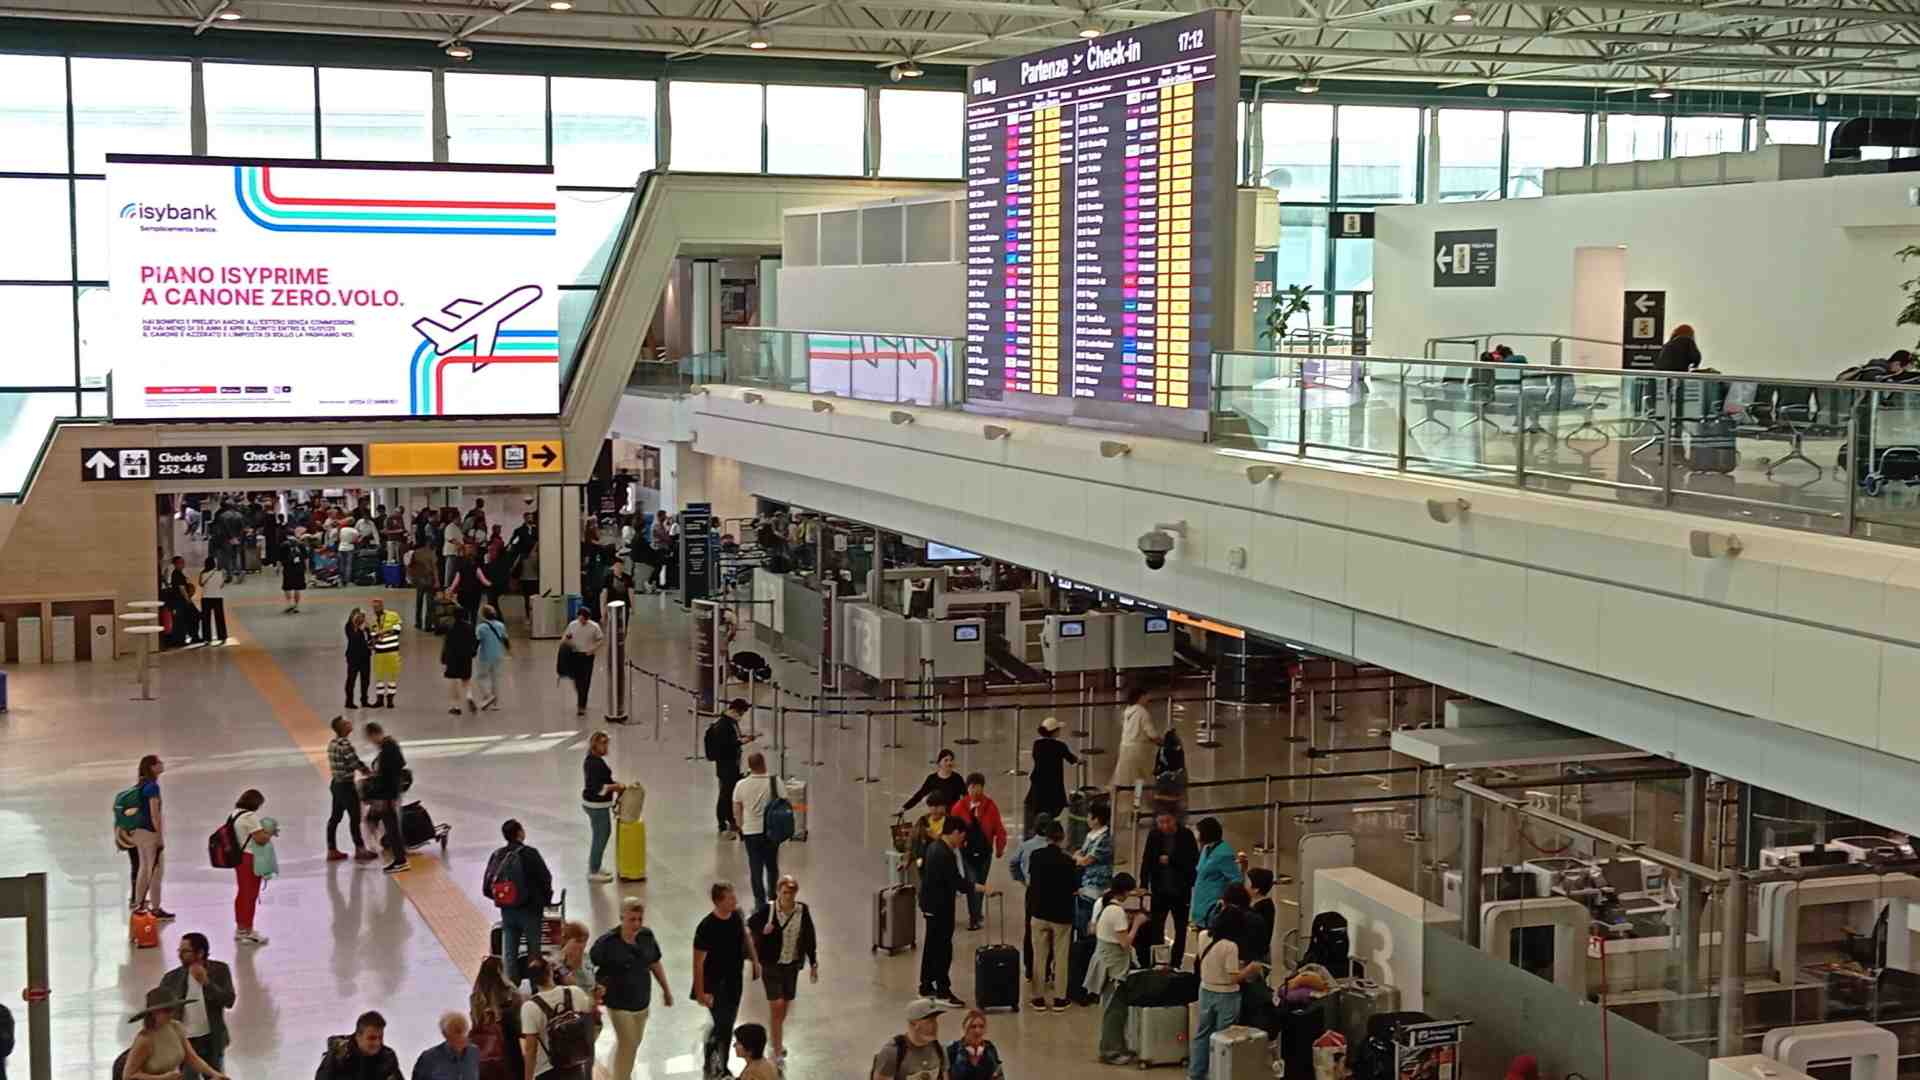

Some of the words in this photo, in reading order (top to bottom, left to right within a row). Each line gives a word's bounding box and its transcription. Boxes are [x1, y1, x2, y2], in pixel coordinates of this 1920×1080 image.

[1178, 29, 1203, 52] 17:12
[1021, 59, 1068, 85] Partenze
[1087, 42, 1141, 71] Check-in
[139, 202, 217, 222] isybank
[221, 267, 329, 285] ISYPRIME
[142, 289, 158, 305] A
[165, 288, 264, 306] CANONE
[158, 452, 207, 462] Check-in
[243, 451, 291, 461] Check-in
[159, 464, 205, 474] 252-445
[247, 463, 291, 473] 226-251
